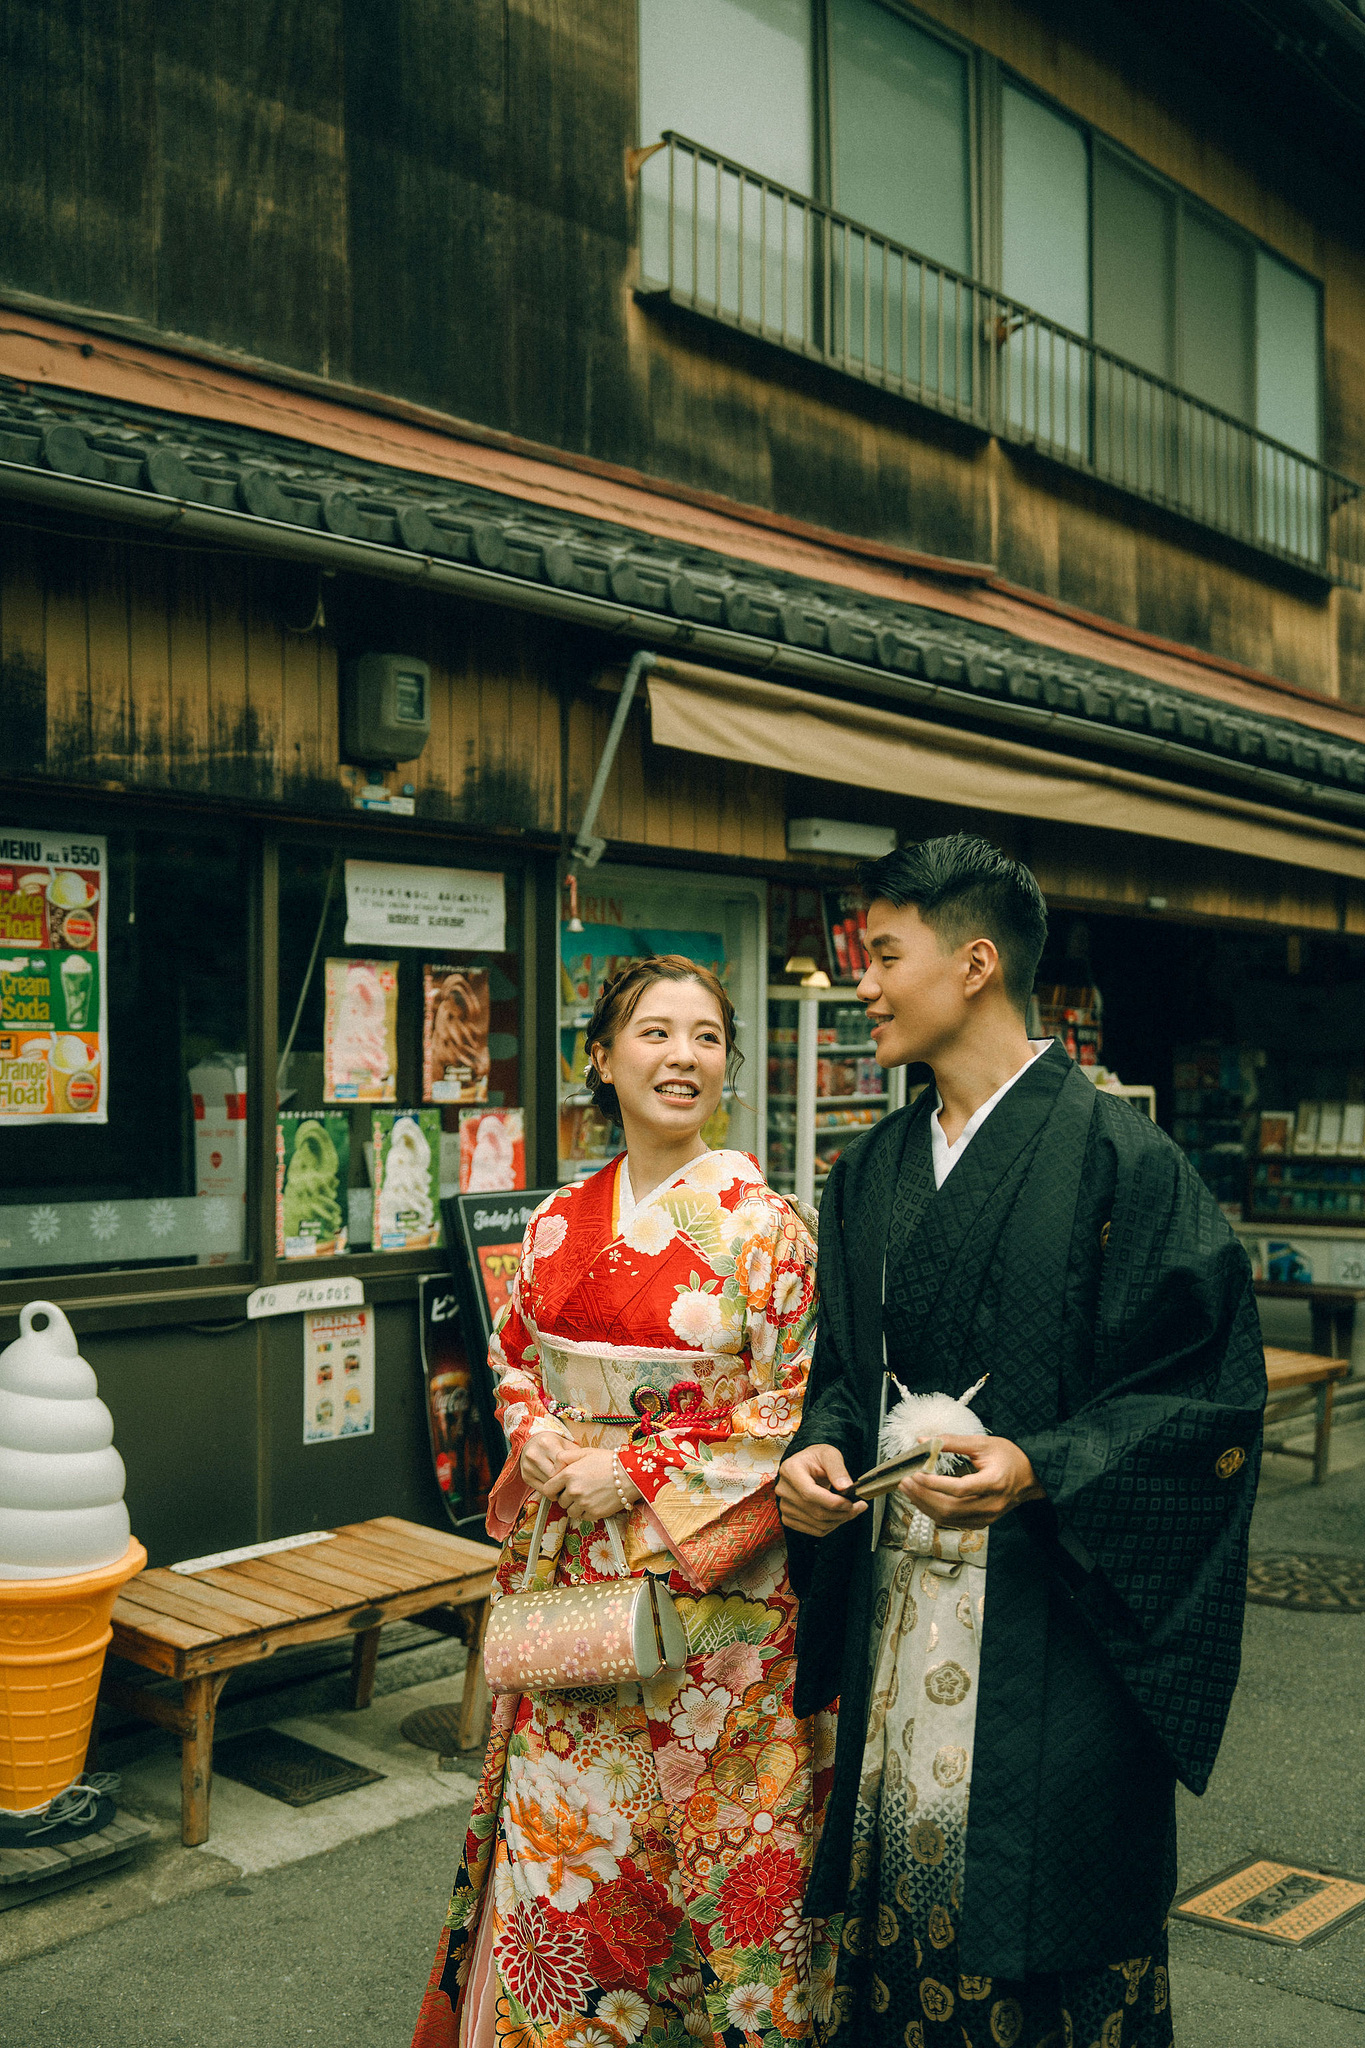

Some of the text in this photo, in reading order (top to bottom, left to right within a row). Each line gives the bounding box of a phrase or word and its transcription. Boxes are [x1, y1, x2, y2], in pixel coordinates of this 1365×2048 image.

[1, 970, 51, 996] Cream
[2, 995, 50, 1020] Soda
[473, 1207, 519, 1232] Today's
[256, 1292, 277, 1308] NO
[312, 1313, 363, 1329] DRINK
